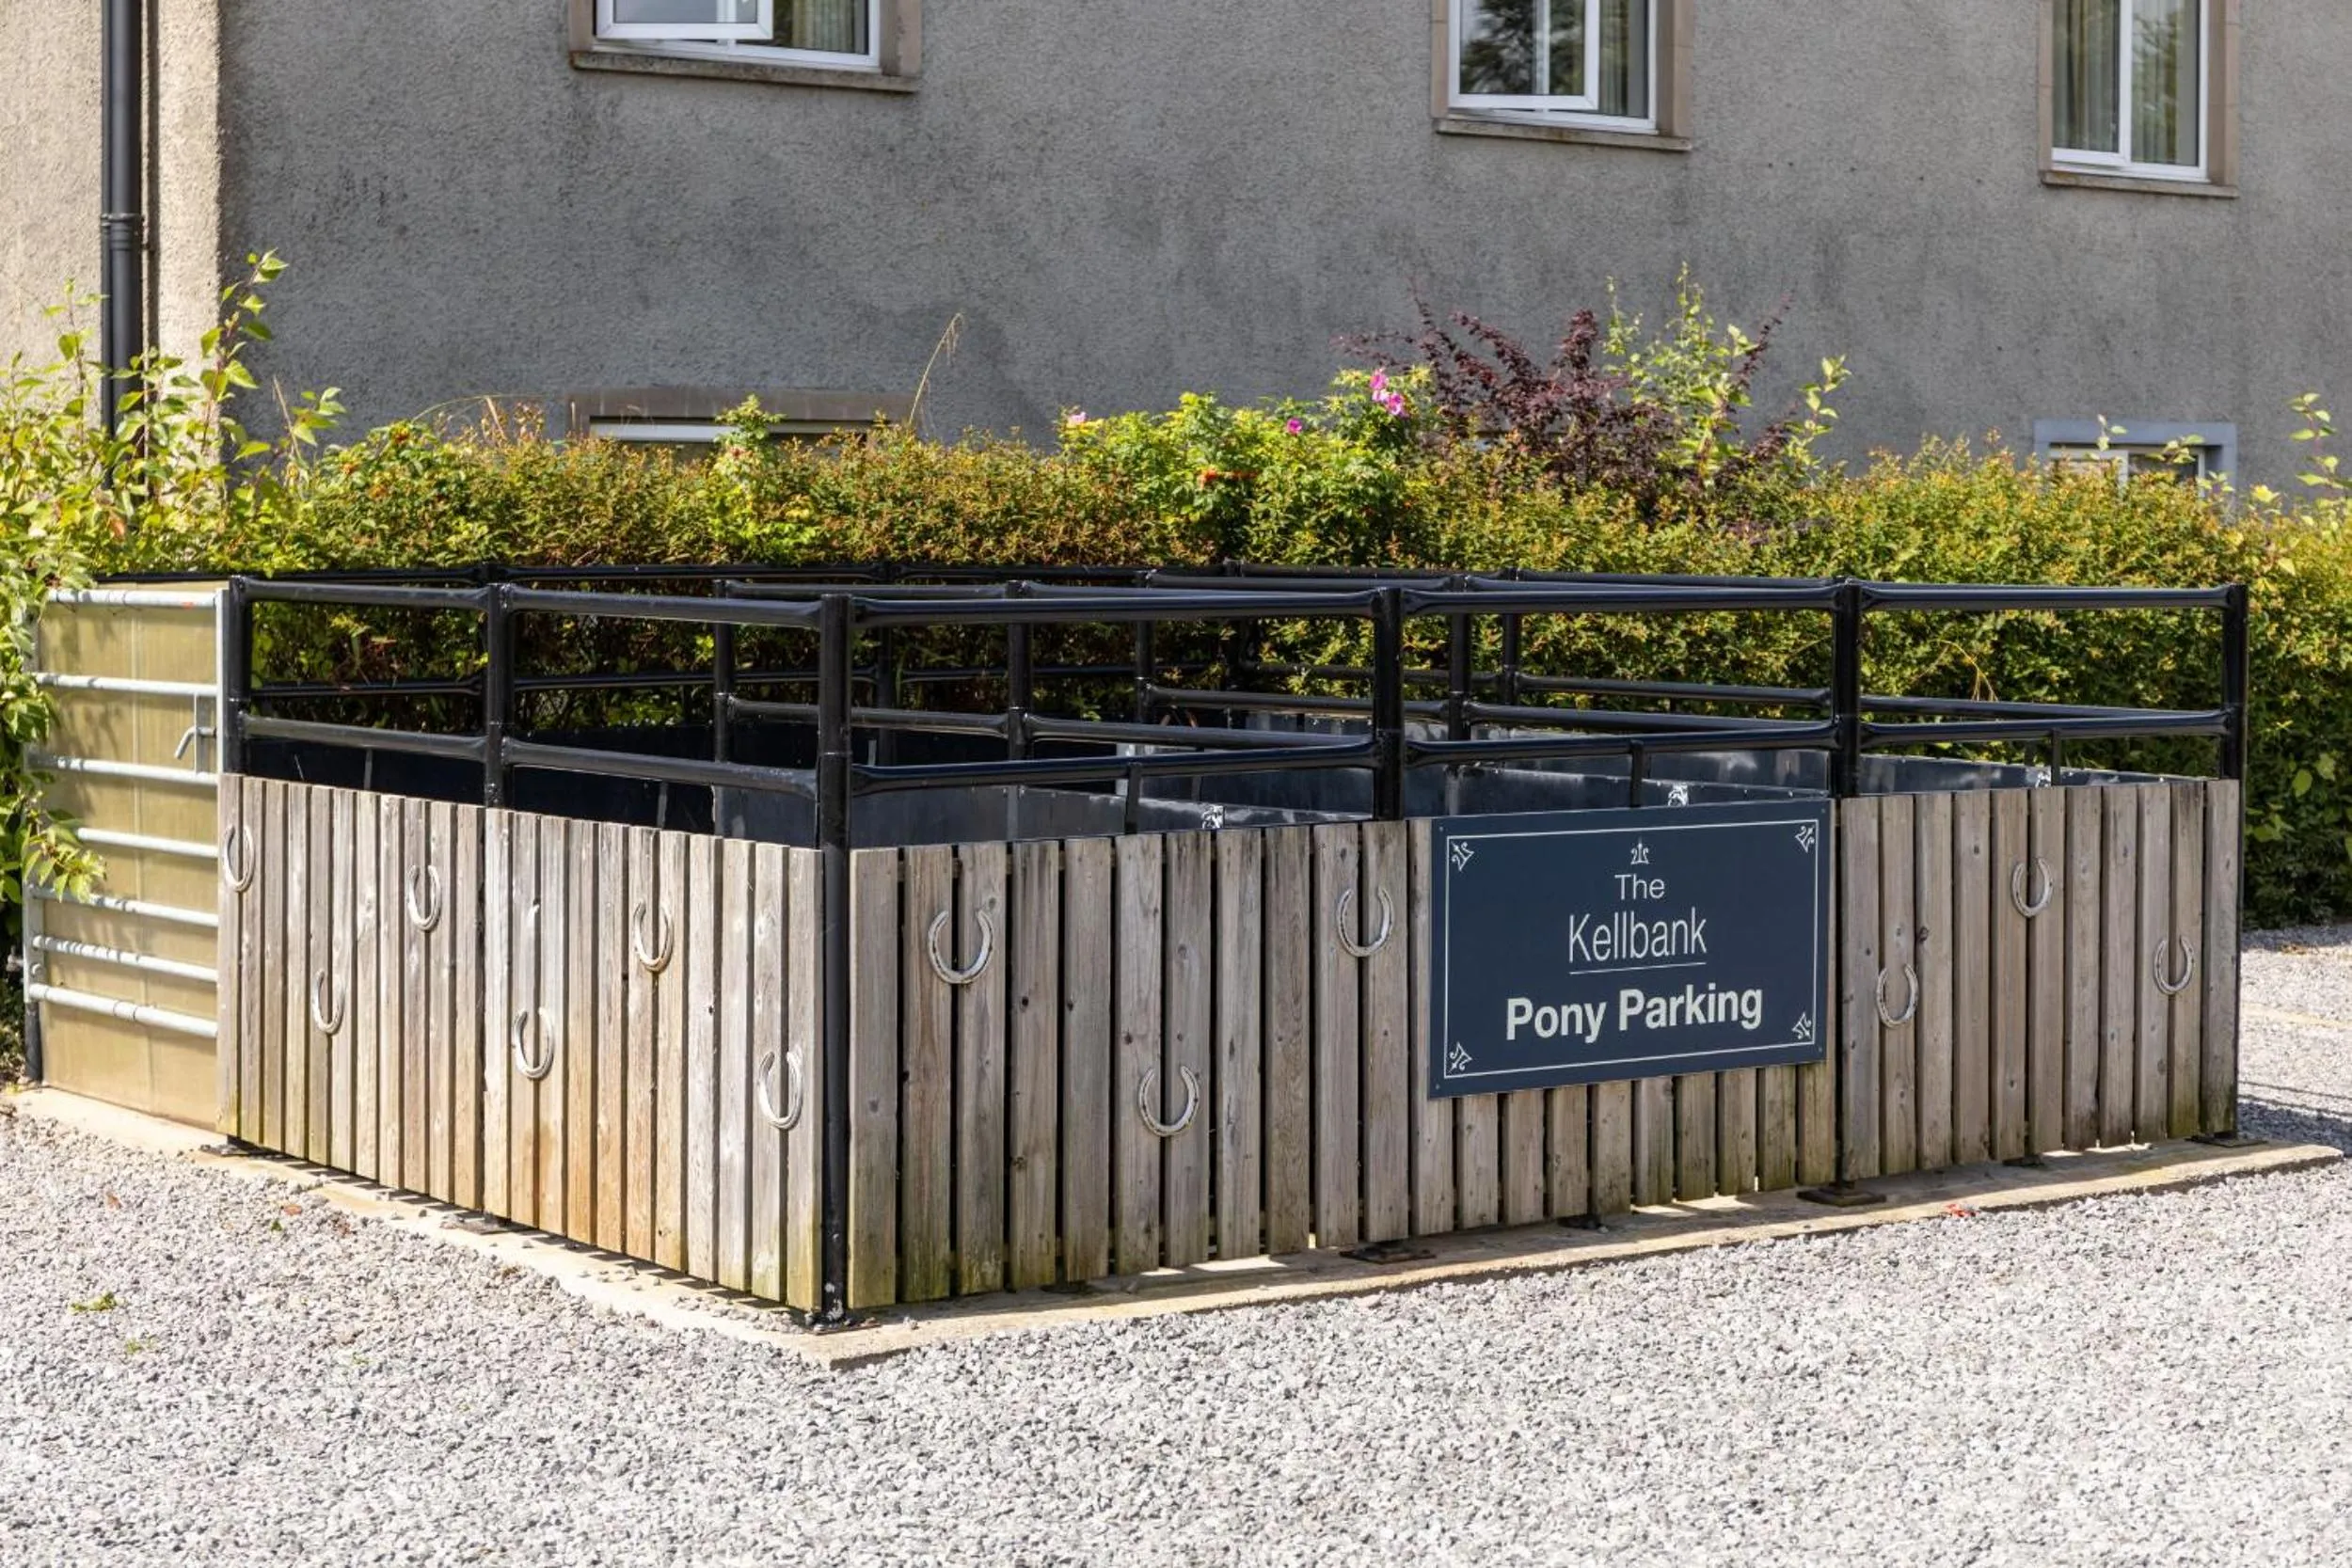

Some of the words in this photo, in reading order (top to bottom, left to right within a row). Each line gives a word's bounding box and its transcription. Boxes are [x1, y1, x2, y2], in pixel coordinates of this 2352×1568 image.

[1614, 874, 1665, 900] The
[1569, 907, 1708, 963] Kellbank
[1506, 997, 1607, 1044] Pony
[1618, 983, 1763, 1032] Parking
